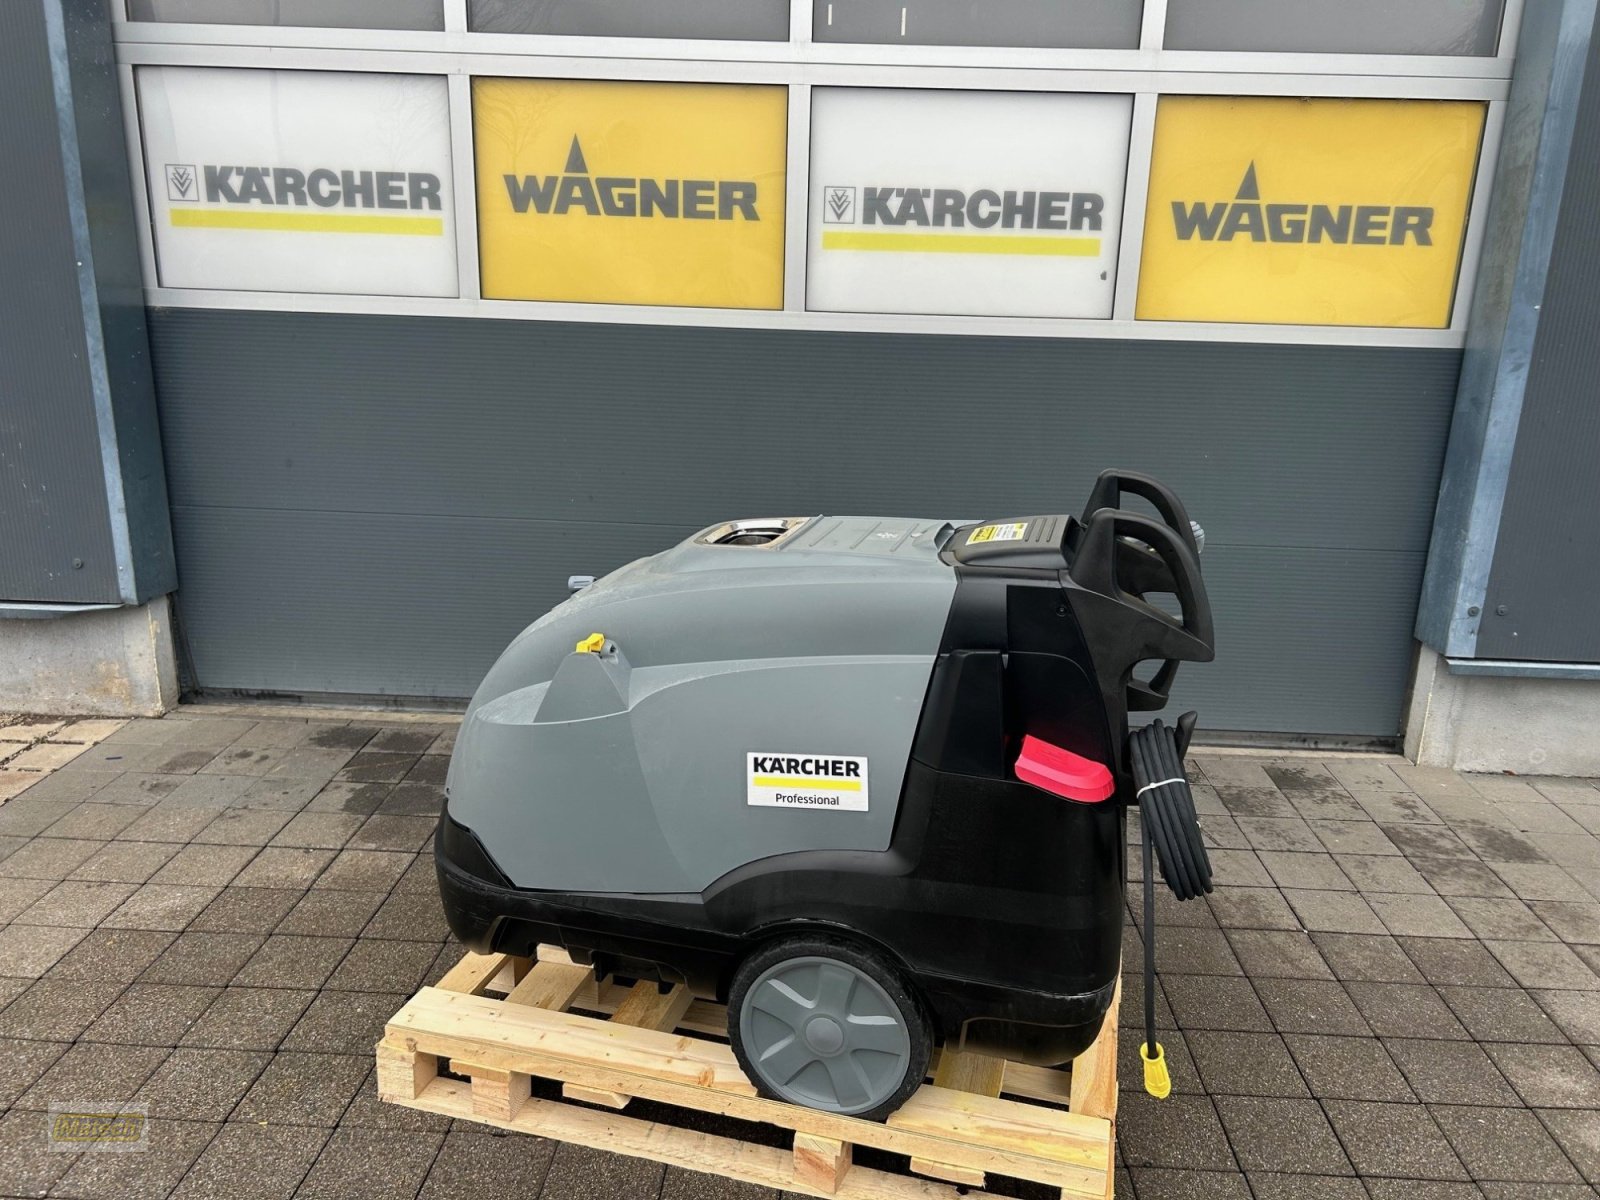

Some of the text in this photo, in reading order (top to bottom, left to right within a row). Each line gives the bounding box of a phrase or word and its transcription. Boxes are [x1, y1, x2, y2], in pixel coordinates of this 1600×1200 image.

[204, 165, 442, 211] KÄRCHER
[503, 173, 761, 221] WAGNER
[862, 187, 1105, 231] KÄRCHER
[1171, 201, 1434, 247] WAGNER
[753, 756, 860, 778] KÄRCHER
[775, 792, 840, 806] Professional
